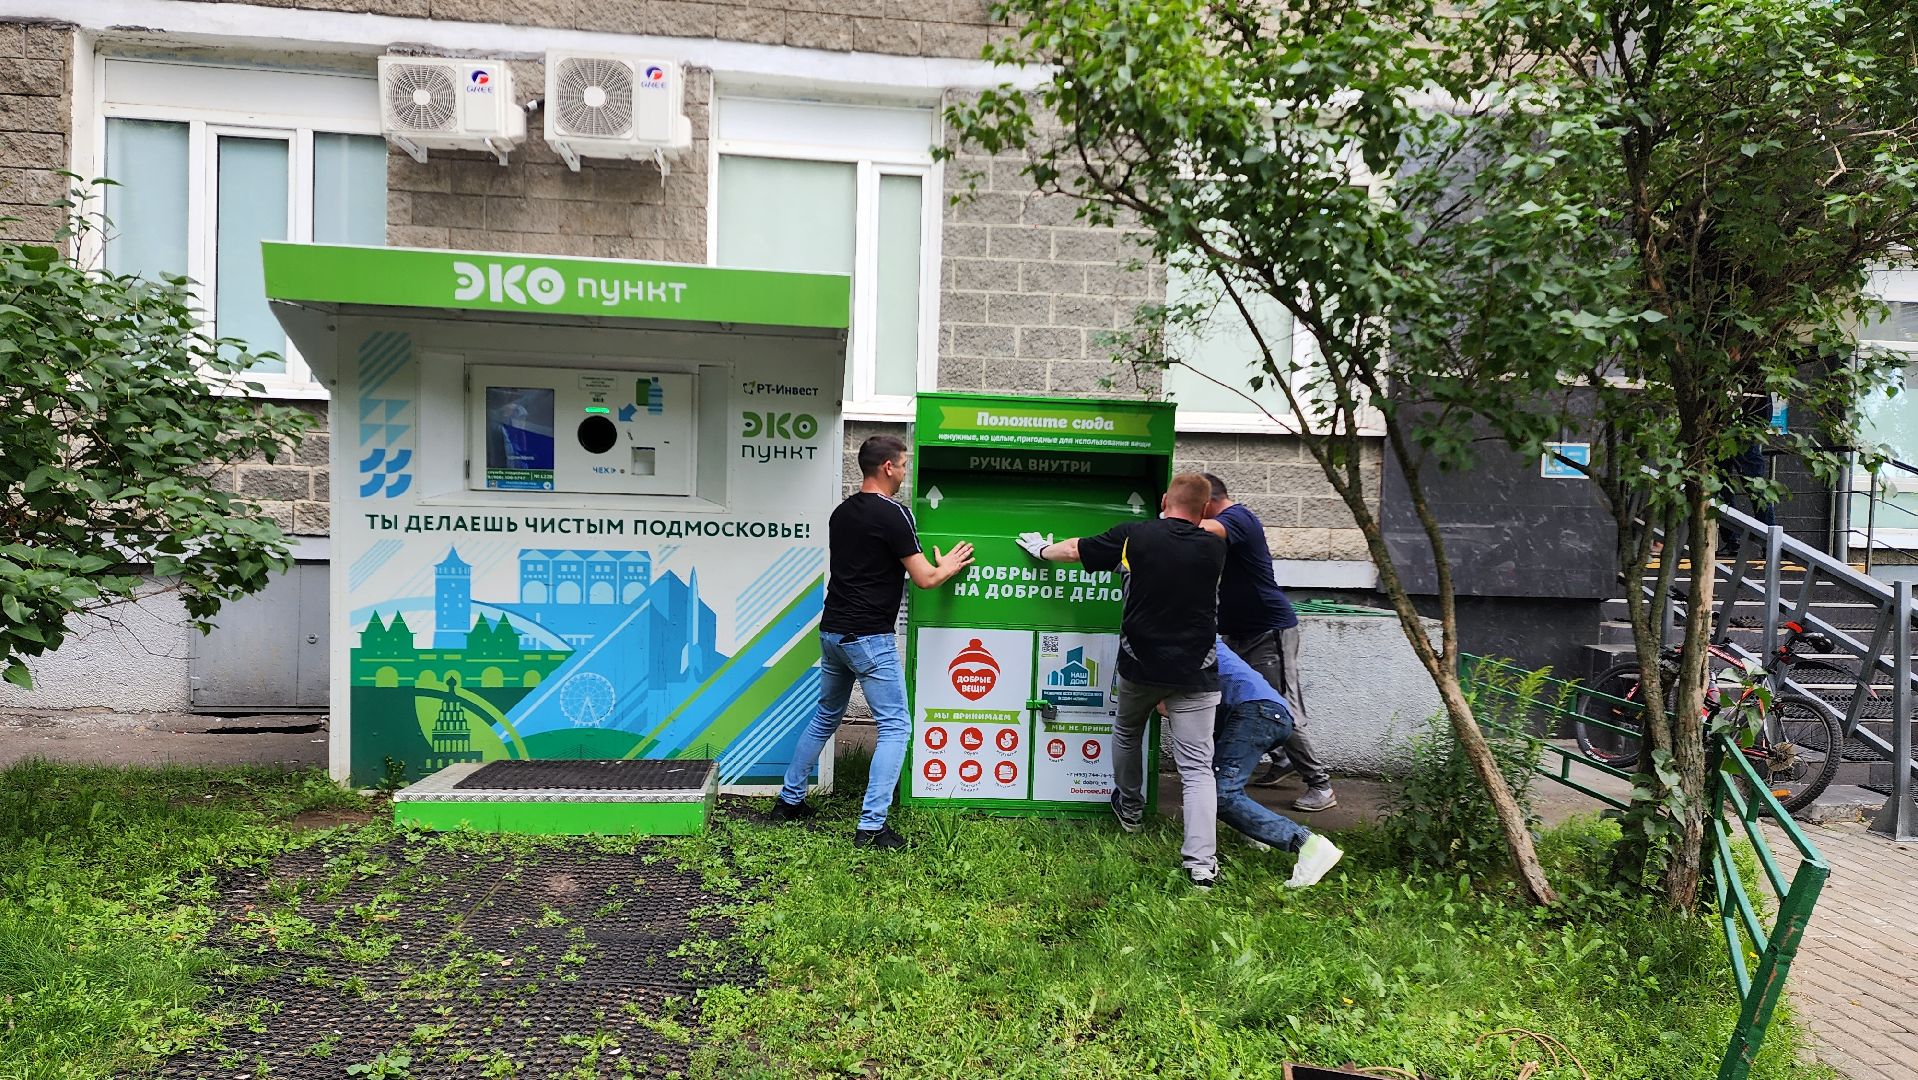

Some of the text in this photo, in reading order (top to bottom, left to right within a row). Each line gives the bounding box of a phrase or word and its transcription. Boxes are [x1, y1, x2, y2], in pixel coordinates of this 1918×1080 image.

[453, 261, 565, 305] ЭКО
[756, 383, 819, 396] РТ-Инвест
[742, 411, 818, 440] ЭКО
[976, 411, 1115, 431] Положите сюда
[969, 456, 1091, 473] РУЧКА ВНУТРИ
[365, 513, 810, 539] ТЫ ДЕЛАЕШЬ ЧИСТЫМ ПОДМОСКОВЬЕ!
[966, 565, 1112, 586] ДОБРЫЕ ВЕЩИ
[954, 583, 1123, 603] НА ДОБРОЕ ДЕЛО
[956, 675, 992, 684] ДОБРЫЕ
[961, 685, 986, 694] ВЕЩИ
[953, 712, 1011, 720] ПРИНИМАЕМ
